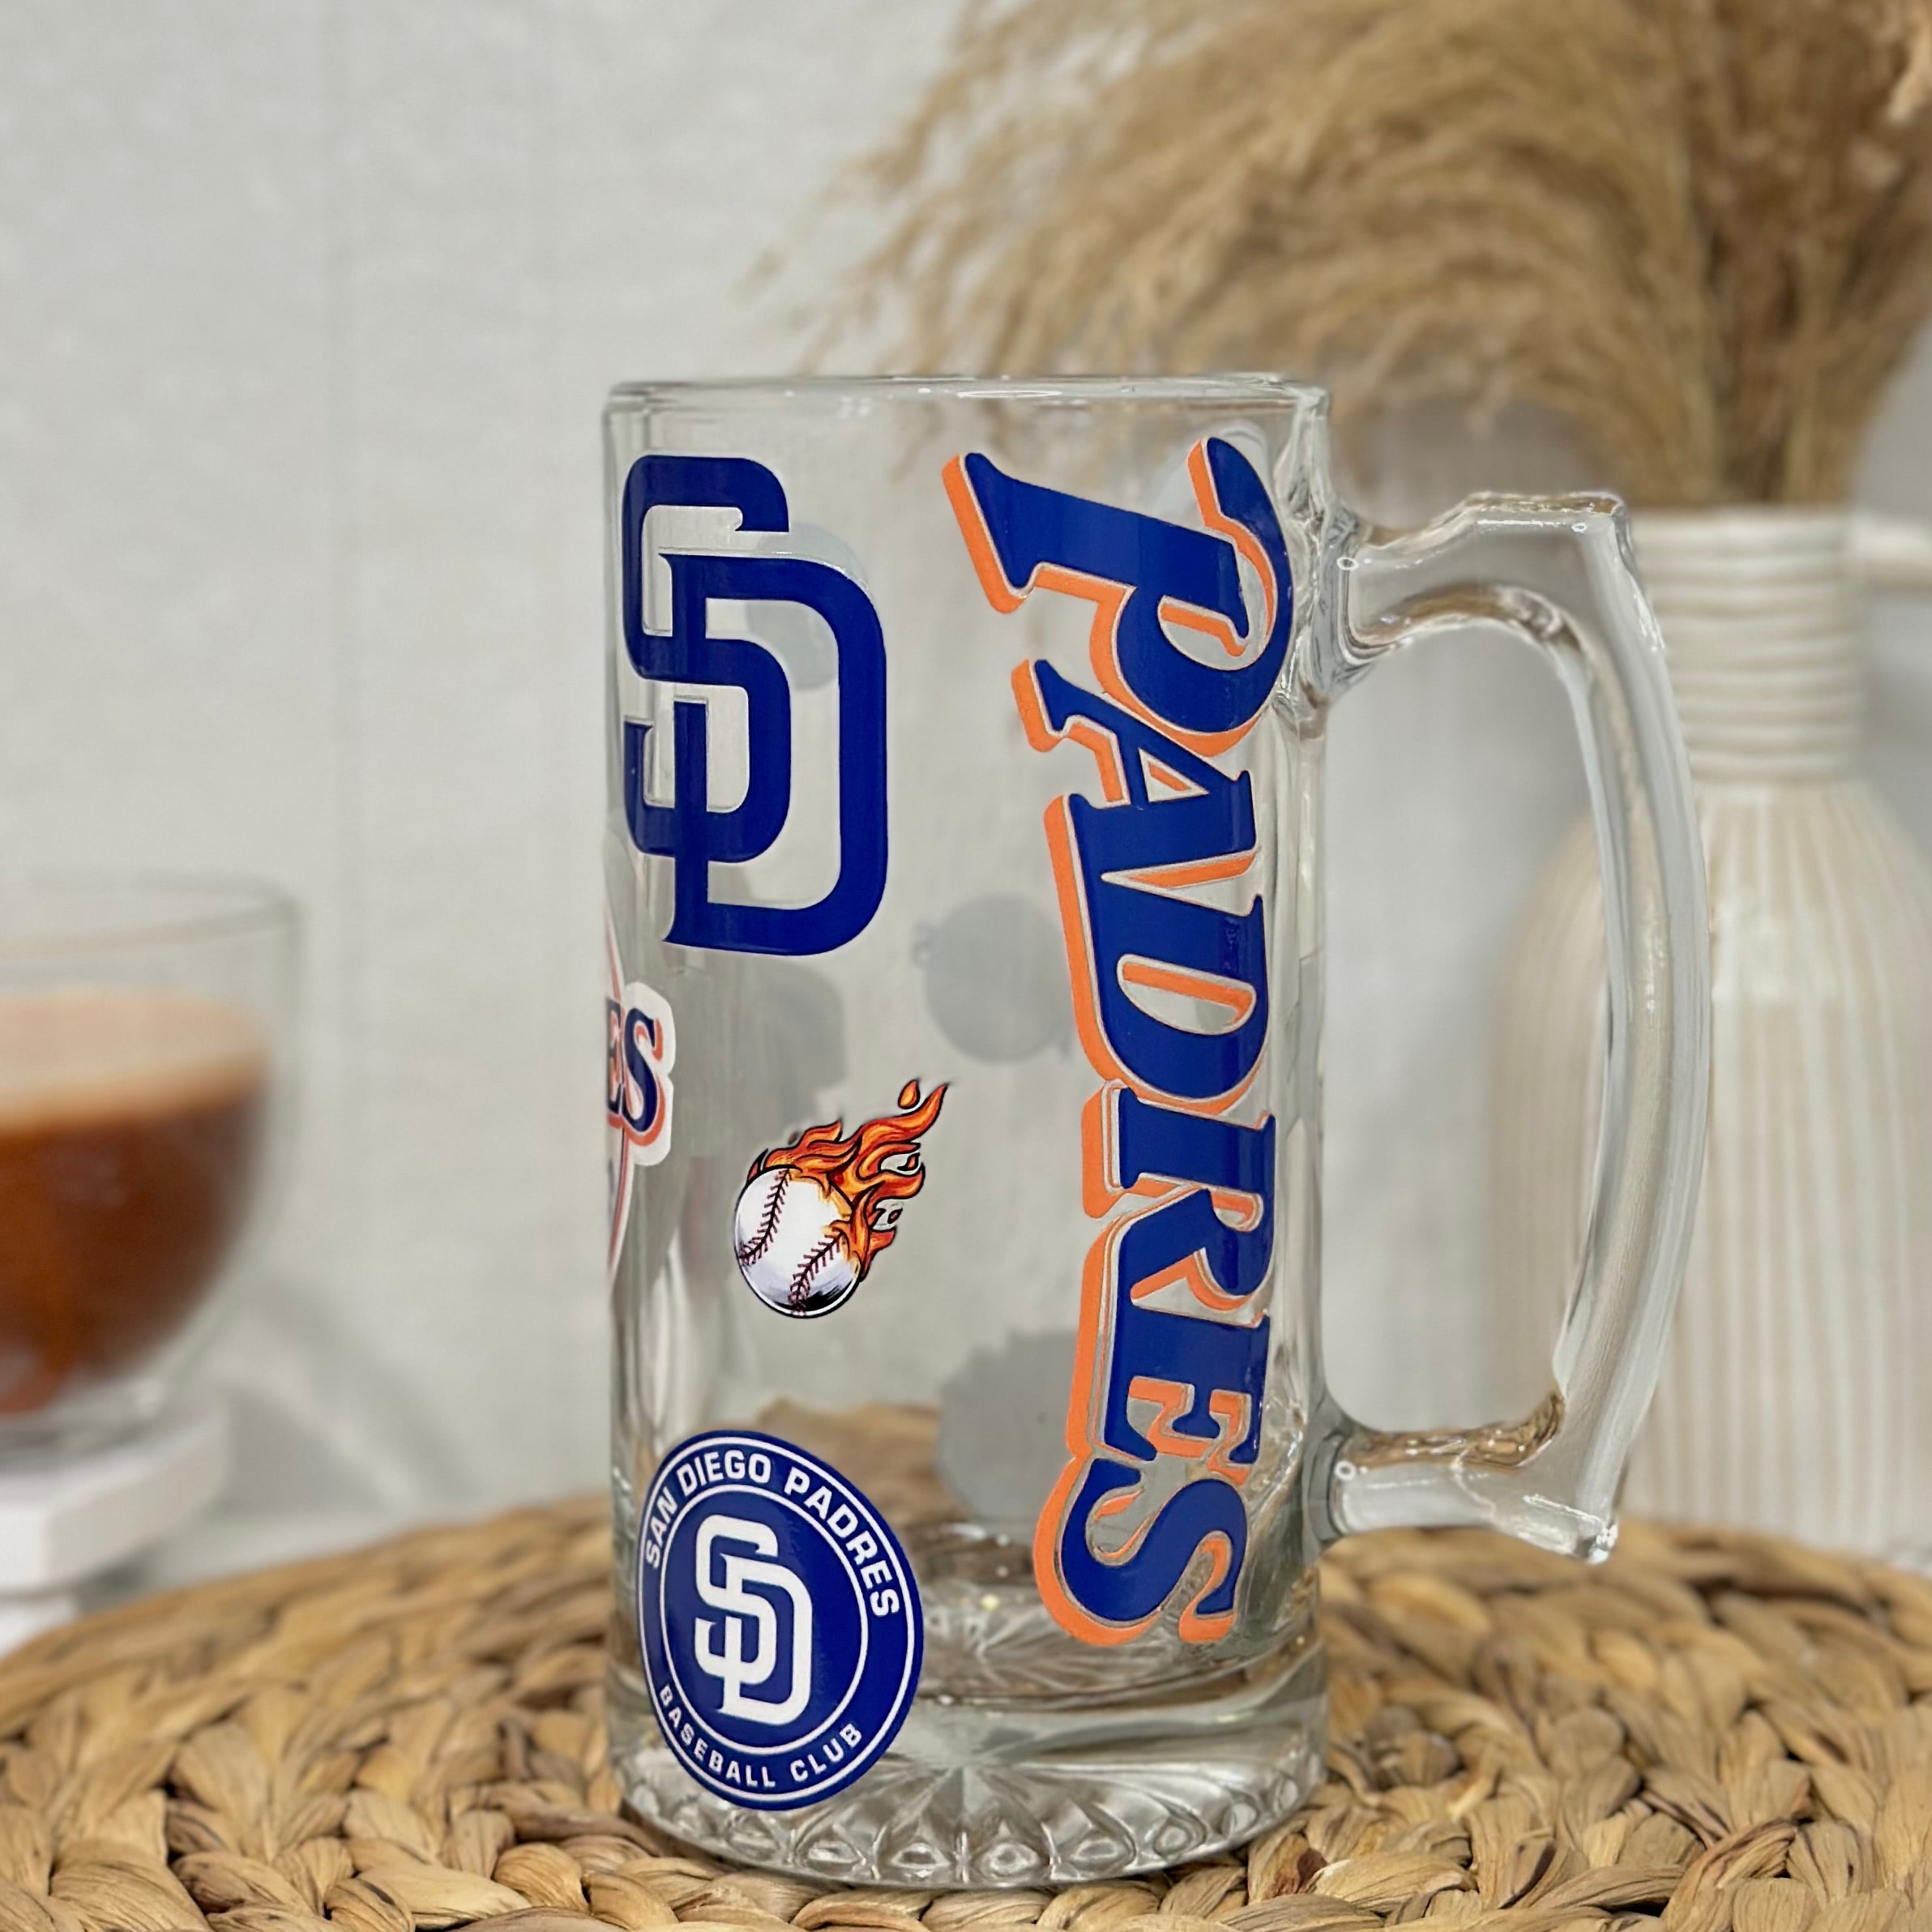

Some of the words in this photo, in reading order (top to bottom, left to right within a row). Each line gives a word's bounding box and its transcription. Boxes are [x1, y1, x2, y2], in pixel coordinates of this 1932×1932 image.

[942, 437, 1294, 1646] PADRES
[646, 1486, 678, 1569] SAN
[678, 1450, 772, 1492] DIEGO
[784, 1468, 900, 1618] PADRES
[660, 1685, 776, 1788] BASEBALL
[789, 1723, 862, 1781] CLUB
